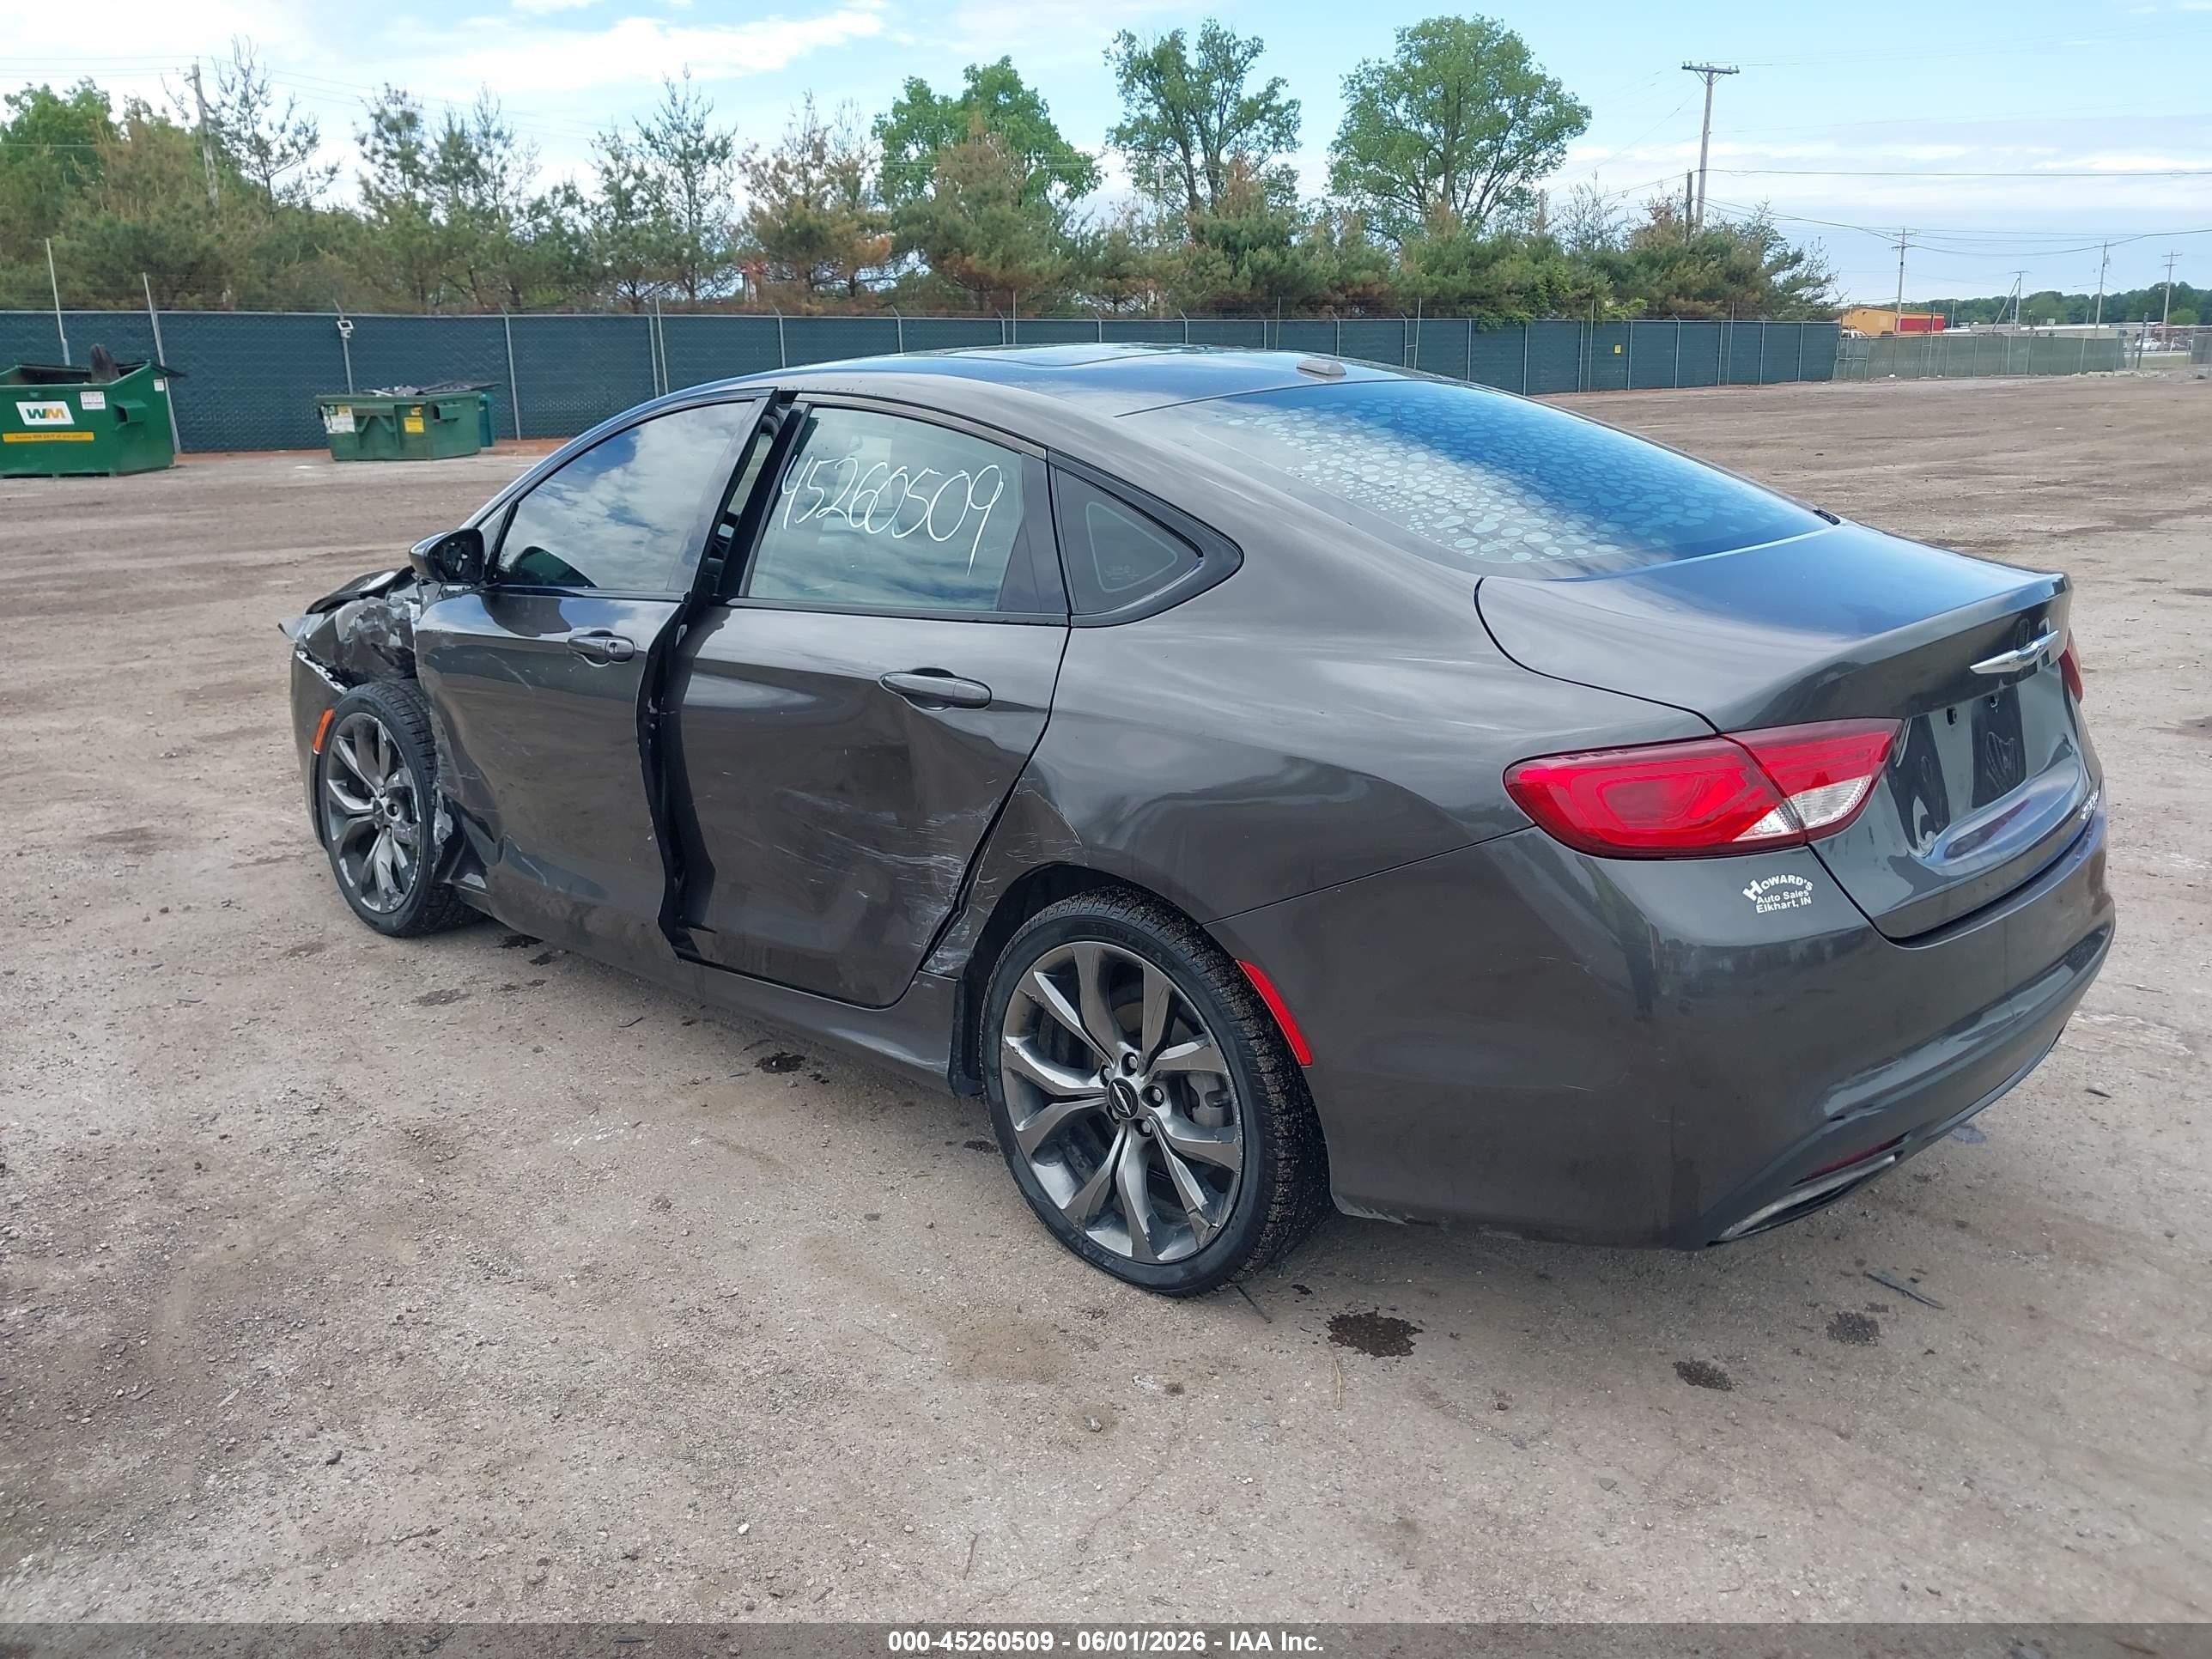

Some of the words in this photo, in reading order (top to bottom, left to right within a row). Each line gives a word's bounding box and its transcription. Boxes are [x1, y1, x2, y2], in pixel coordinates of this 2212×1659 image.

[26, 408, 66, 420] WM
[781, 454, 1004, 577] 45260509
[1742, 874, 1814, 902] HOWARD'S
[1756, 895, 1781, 904] Auto
[1783, 890, 1808, 900] Sales
[1755, 900, 1799, 914] Elkhart,
[1800, 896, 1812, 906] IN
